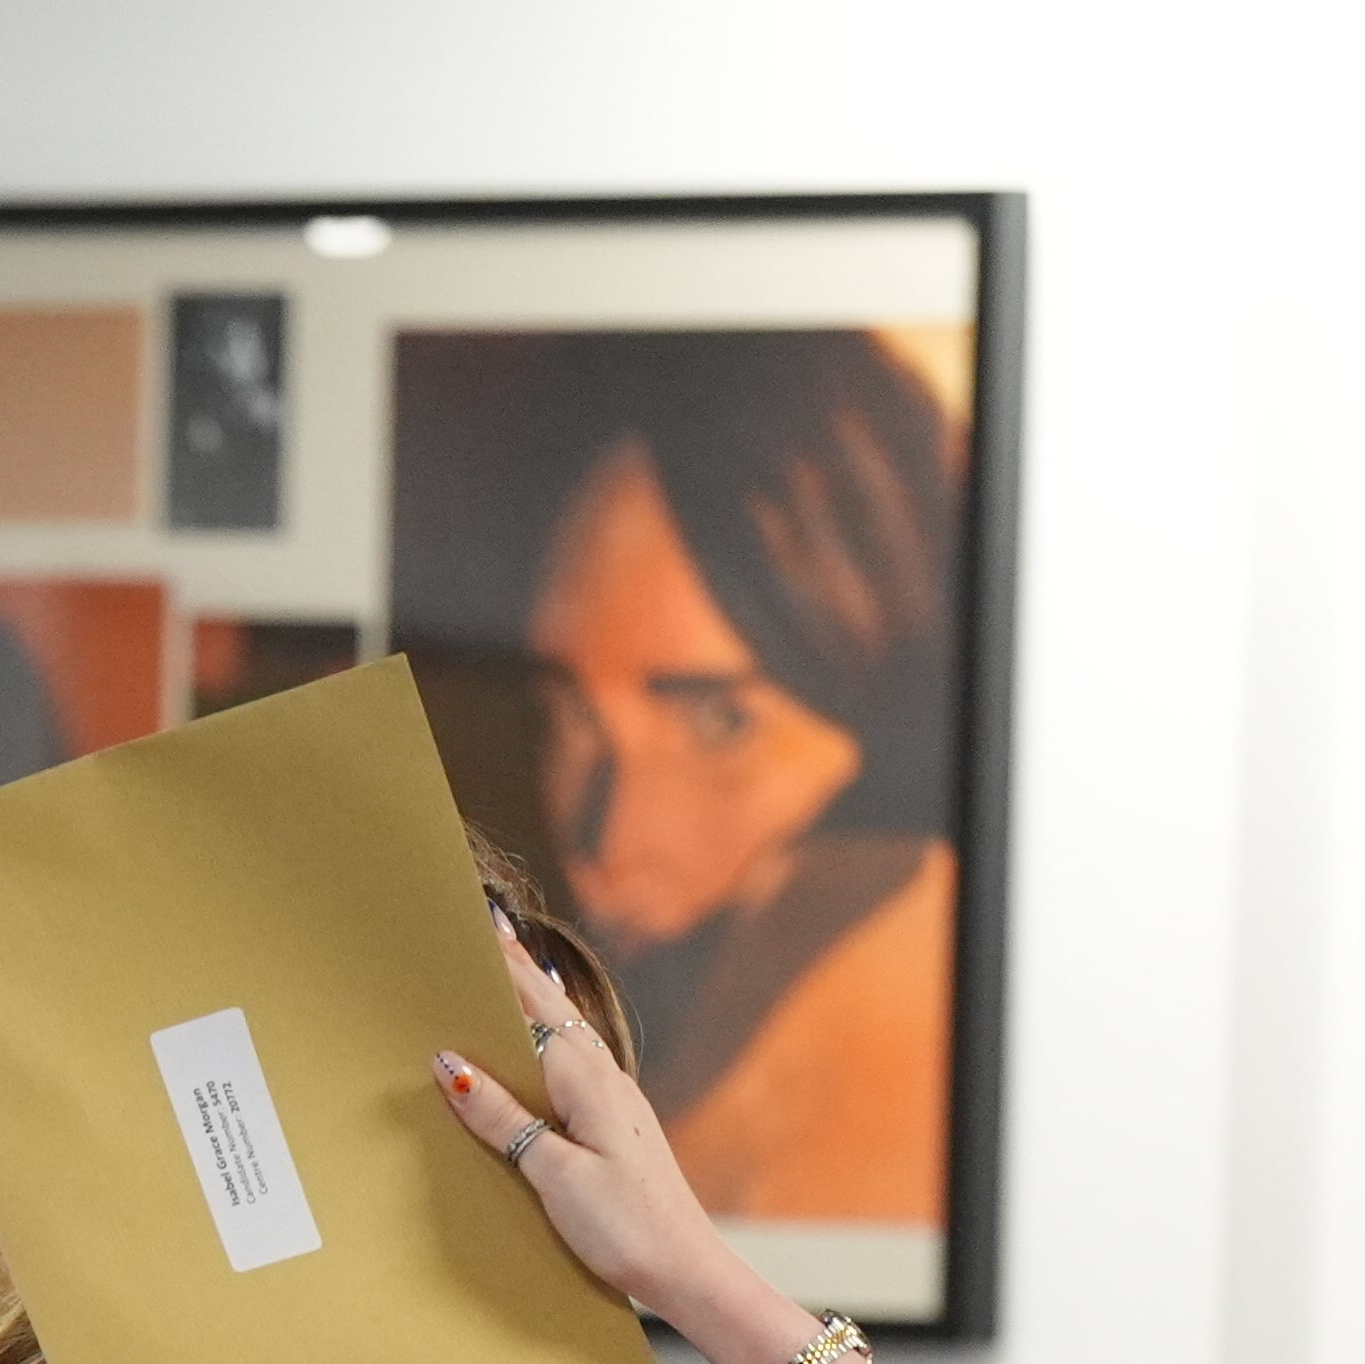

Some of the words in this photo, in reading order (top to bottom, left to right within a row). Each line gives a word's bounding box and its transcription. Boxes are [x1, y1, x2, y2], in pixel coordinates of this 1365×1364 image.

[193, 1088, 214, 1133] Morgan
[222, 1082, 240, 1113] 20772
[210, 1136, 227, 1170] Grace
[220, 1172, 240, 1206] Isabel
[234, 1154, 256, 1204] Candidate
[251, 1160, 268, 1194] Centre
